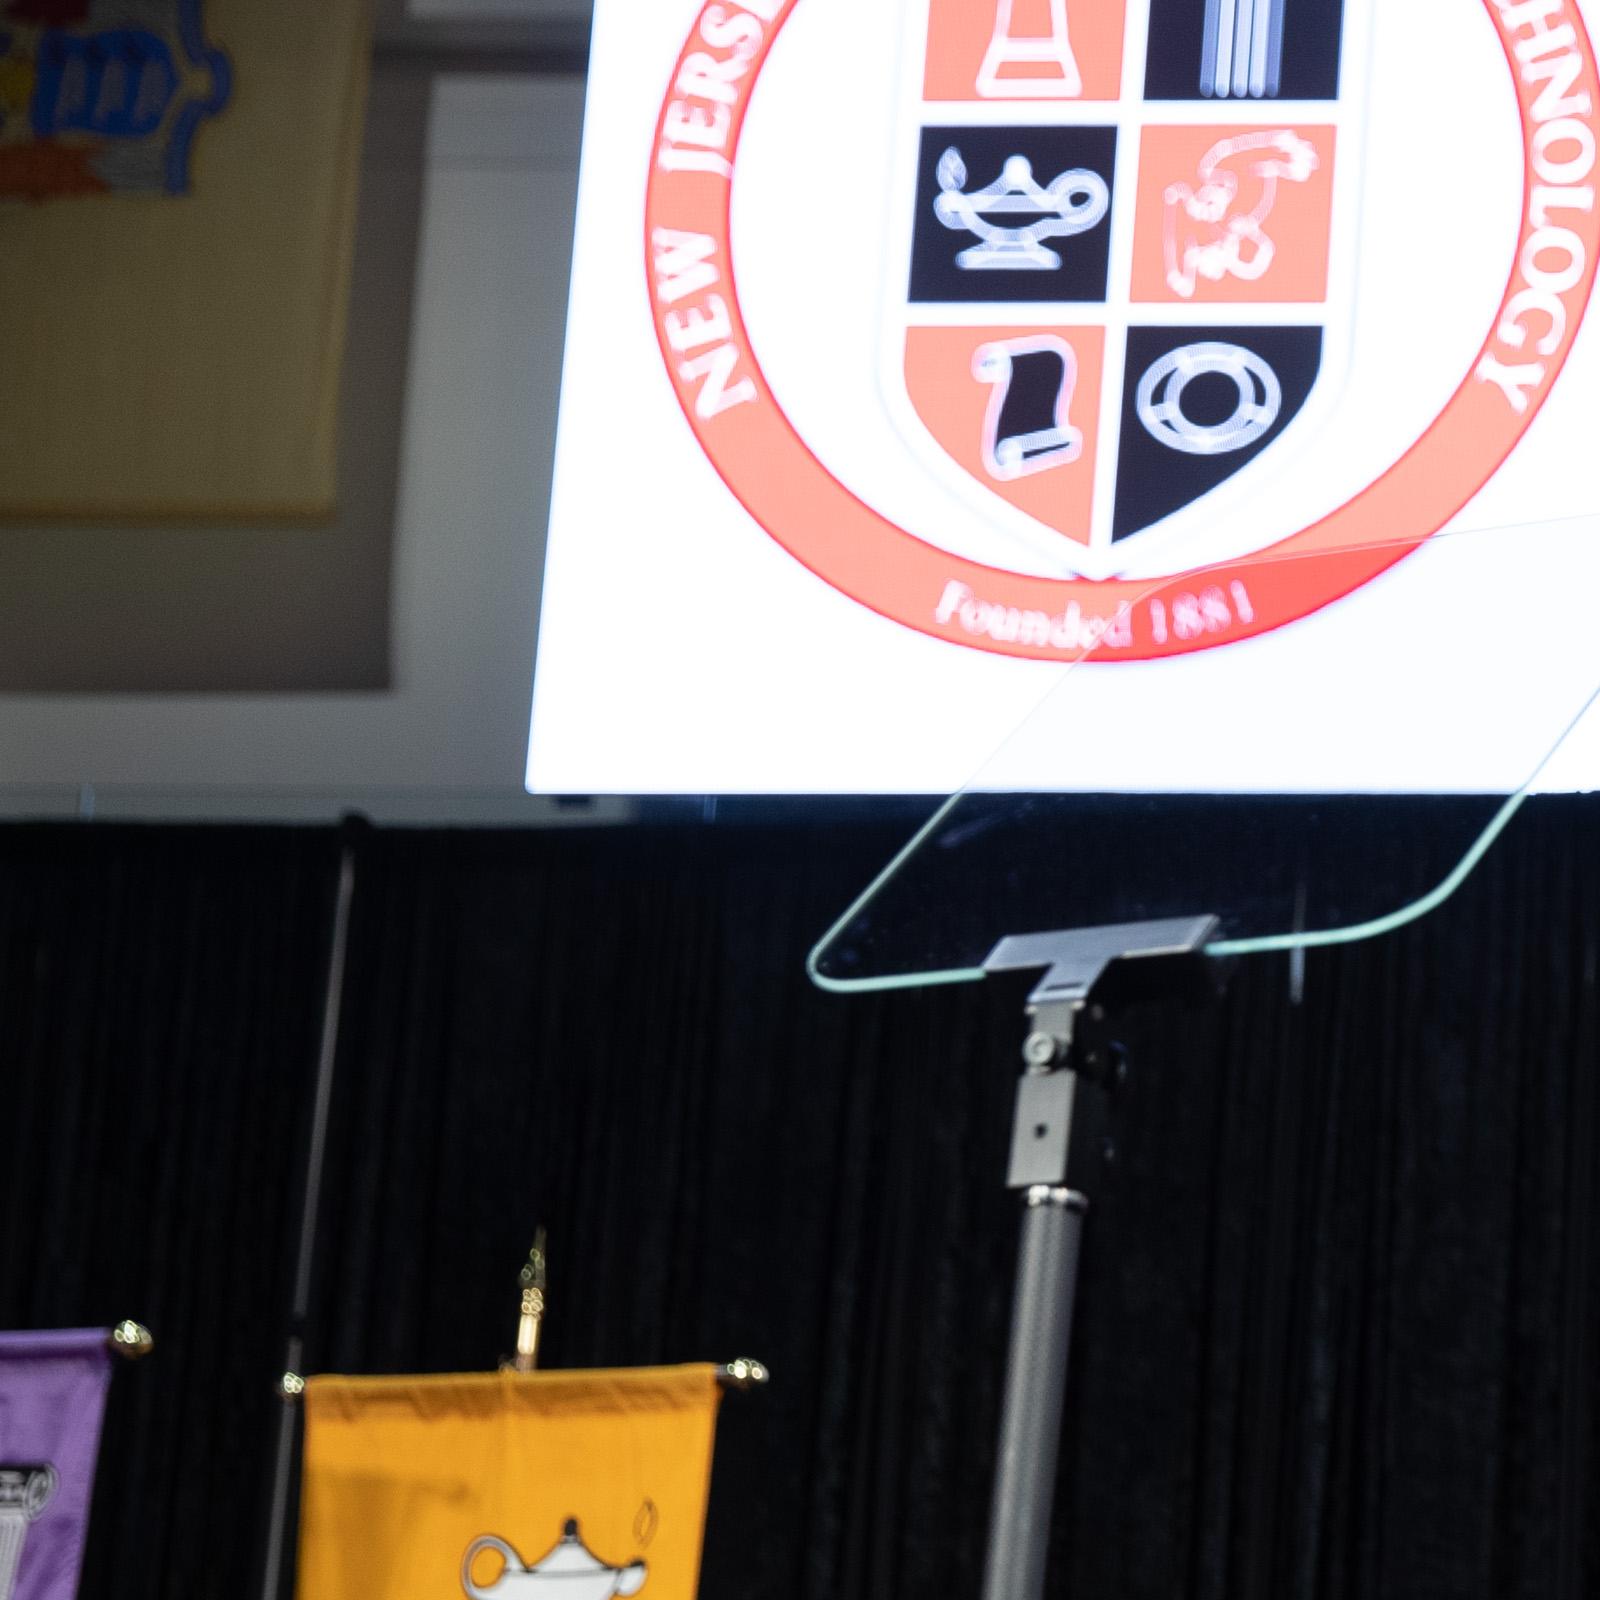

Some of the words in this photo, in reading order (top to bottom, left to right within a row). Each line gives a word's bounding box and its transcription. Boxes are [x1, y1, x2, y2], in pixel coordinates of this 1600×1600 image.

[657, 0, 789, 179] JERS
[1474, 0, 1596, 414] HNOLOGY
[652, 226, 758, 420] NEW
[935, 580, 1134, 649] Founded
[1149, 579, 1254, 644] 1881
